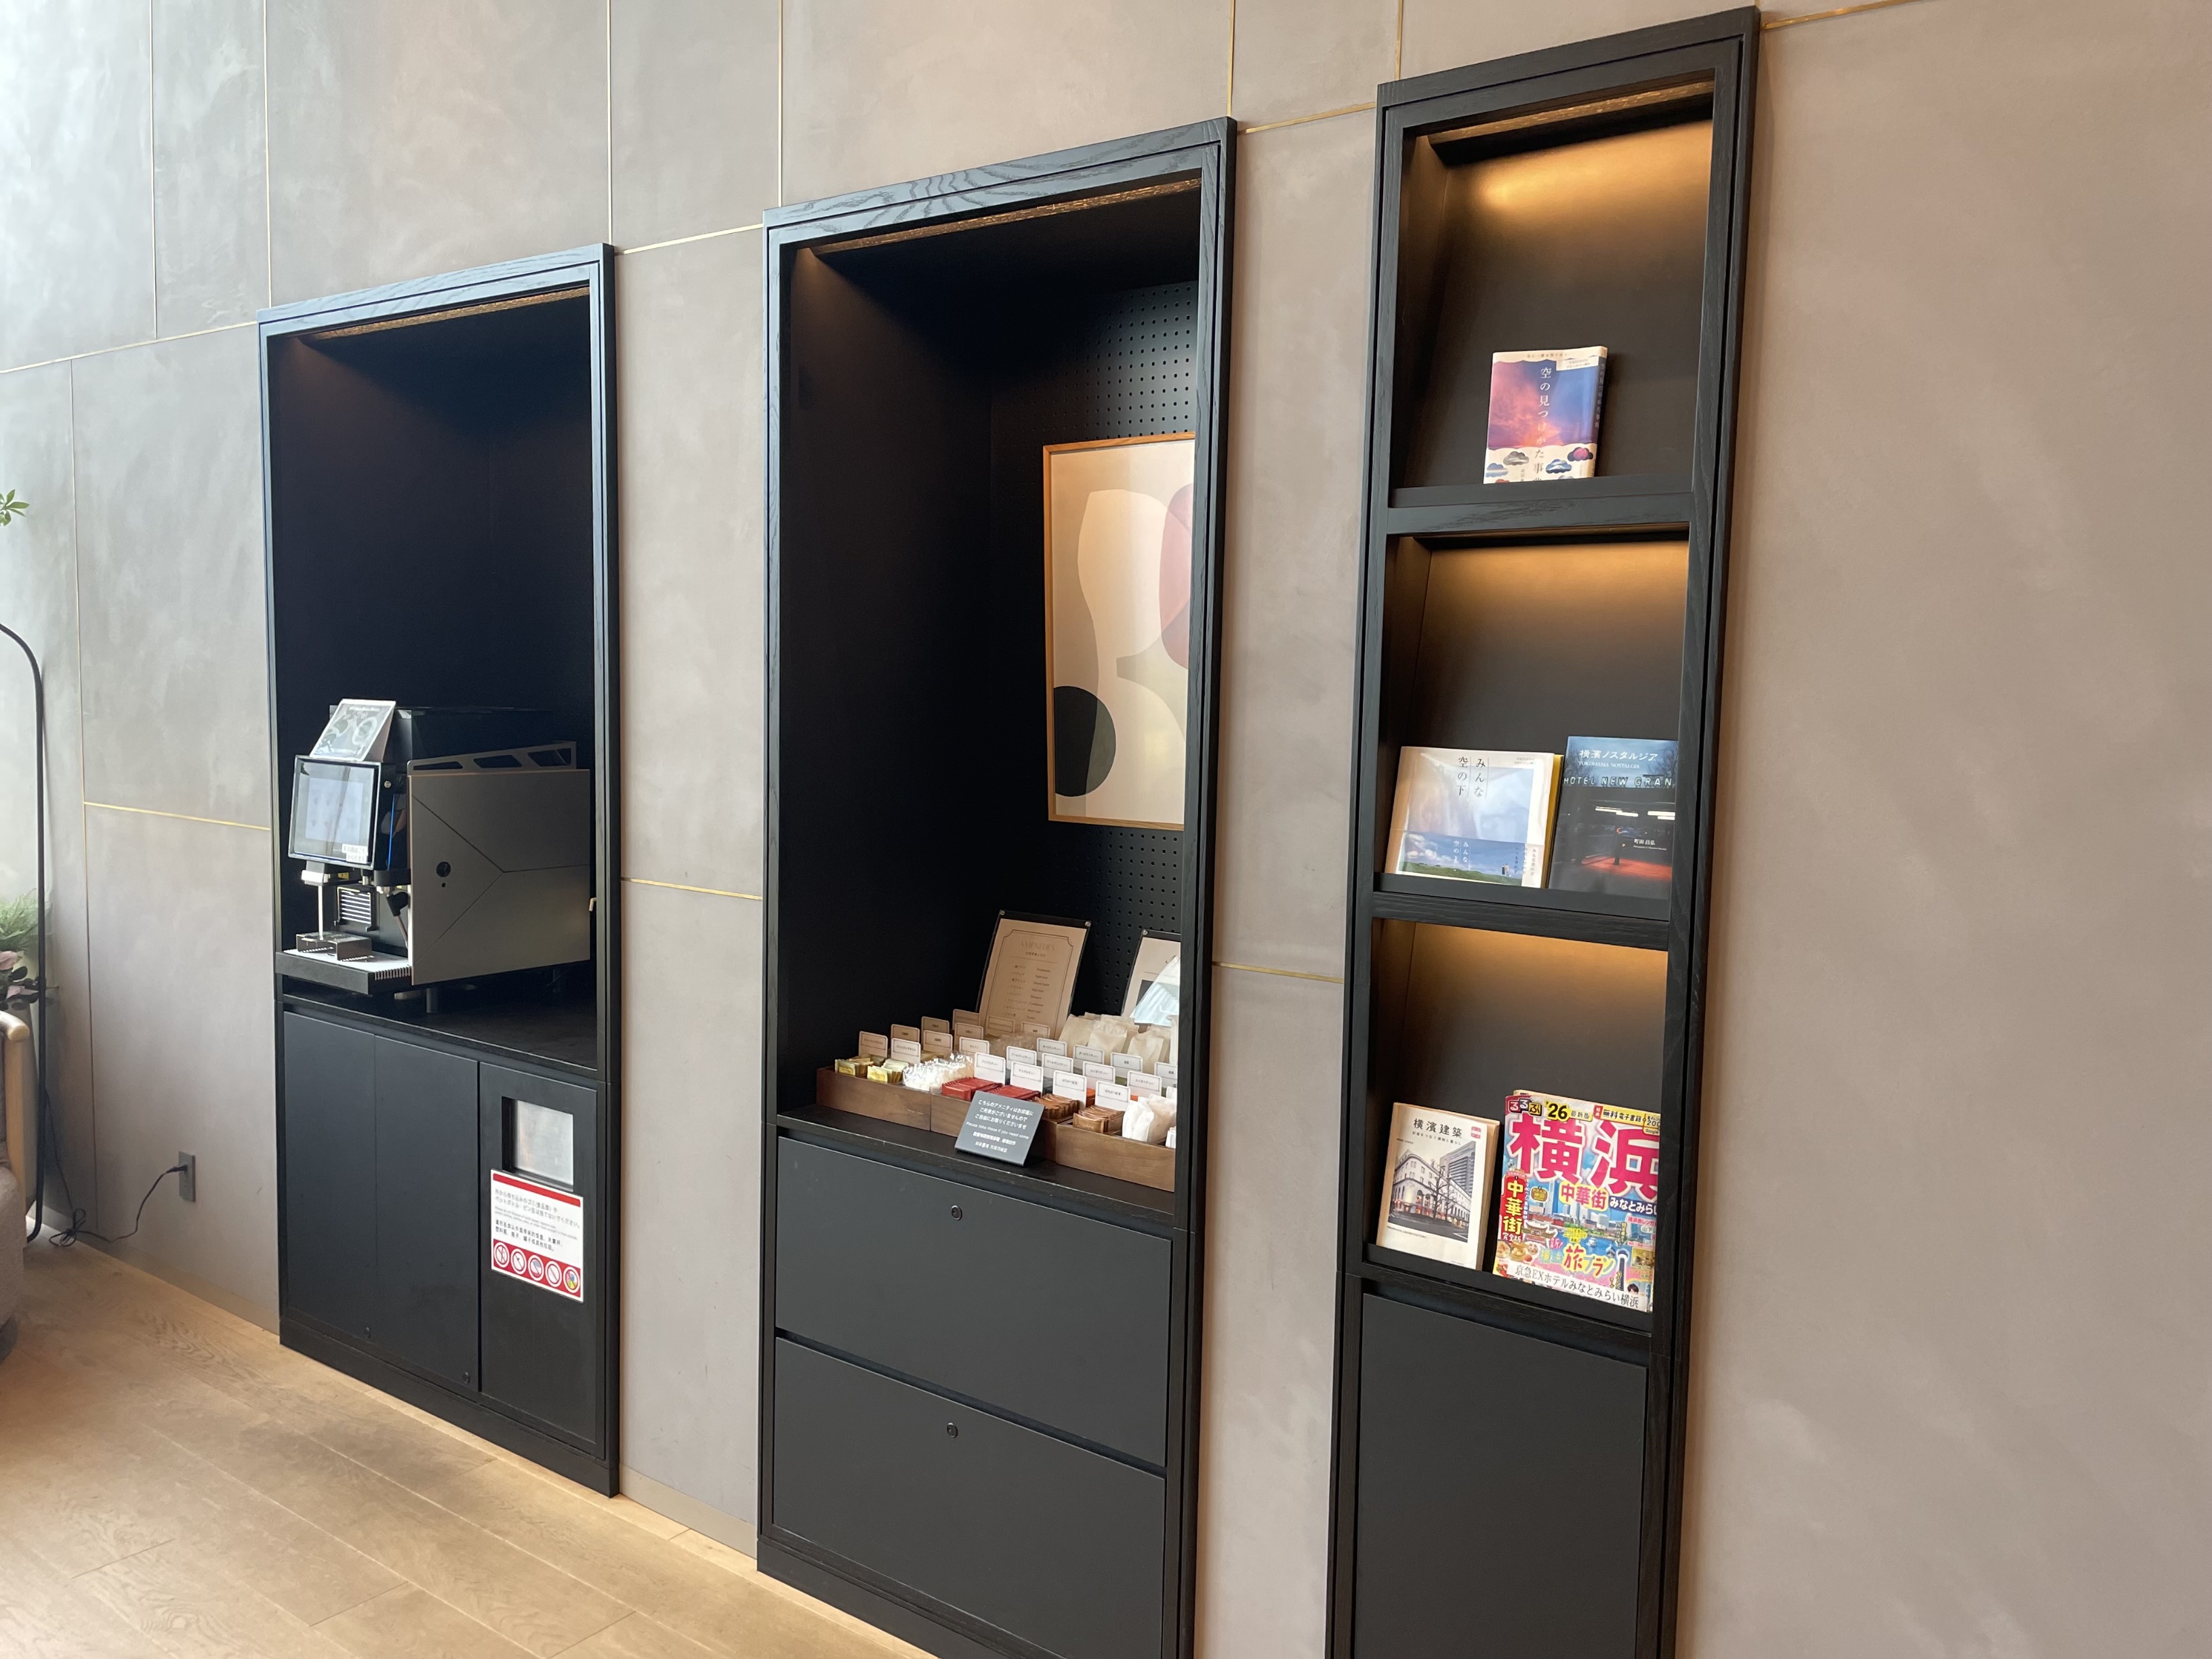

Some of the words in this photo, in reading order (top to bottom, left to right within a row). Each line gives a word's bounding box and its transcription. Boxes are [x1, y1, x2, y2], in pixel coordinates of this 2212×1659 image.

[1579, 750, 1658, 761] 横濱ノスタルジア
[1457, 756, 1468, 796] 空の下
[1475, 758, 1486, 797] みんな
[1563, 777, 1595, 785] HOTEL
[1601, 777, 1628, 785] NEW
[979, 1099, 1034, 1115] こちらのアメニティはお部屋に
[979, 1107, 1028, 1122] ご用意がございませんので
[1509, 1099, 1541, 1115] るるぶ
[1571, 1110, 1590, 1118] 最新版
[975, 1113, 1027, 1130] ご自由にお取りくださいませ
[1414, 1118, 1462, 1139] 横濱建築
[1510, 1113, 1659, 1199] 横浜
[1561, 1184, 1607, 1209] 中華街
[1502, 1181, 1523, 1235] 中華街
[1629, 1216, 1656, 1226] 横浜赤レンガ
[1502, 1233, 1521, 1242] 完全版
[1515, 1265, 1639, 1309] 京急EXホテルみなとみらい横浜
